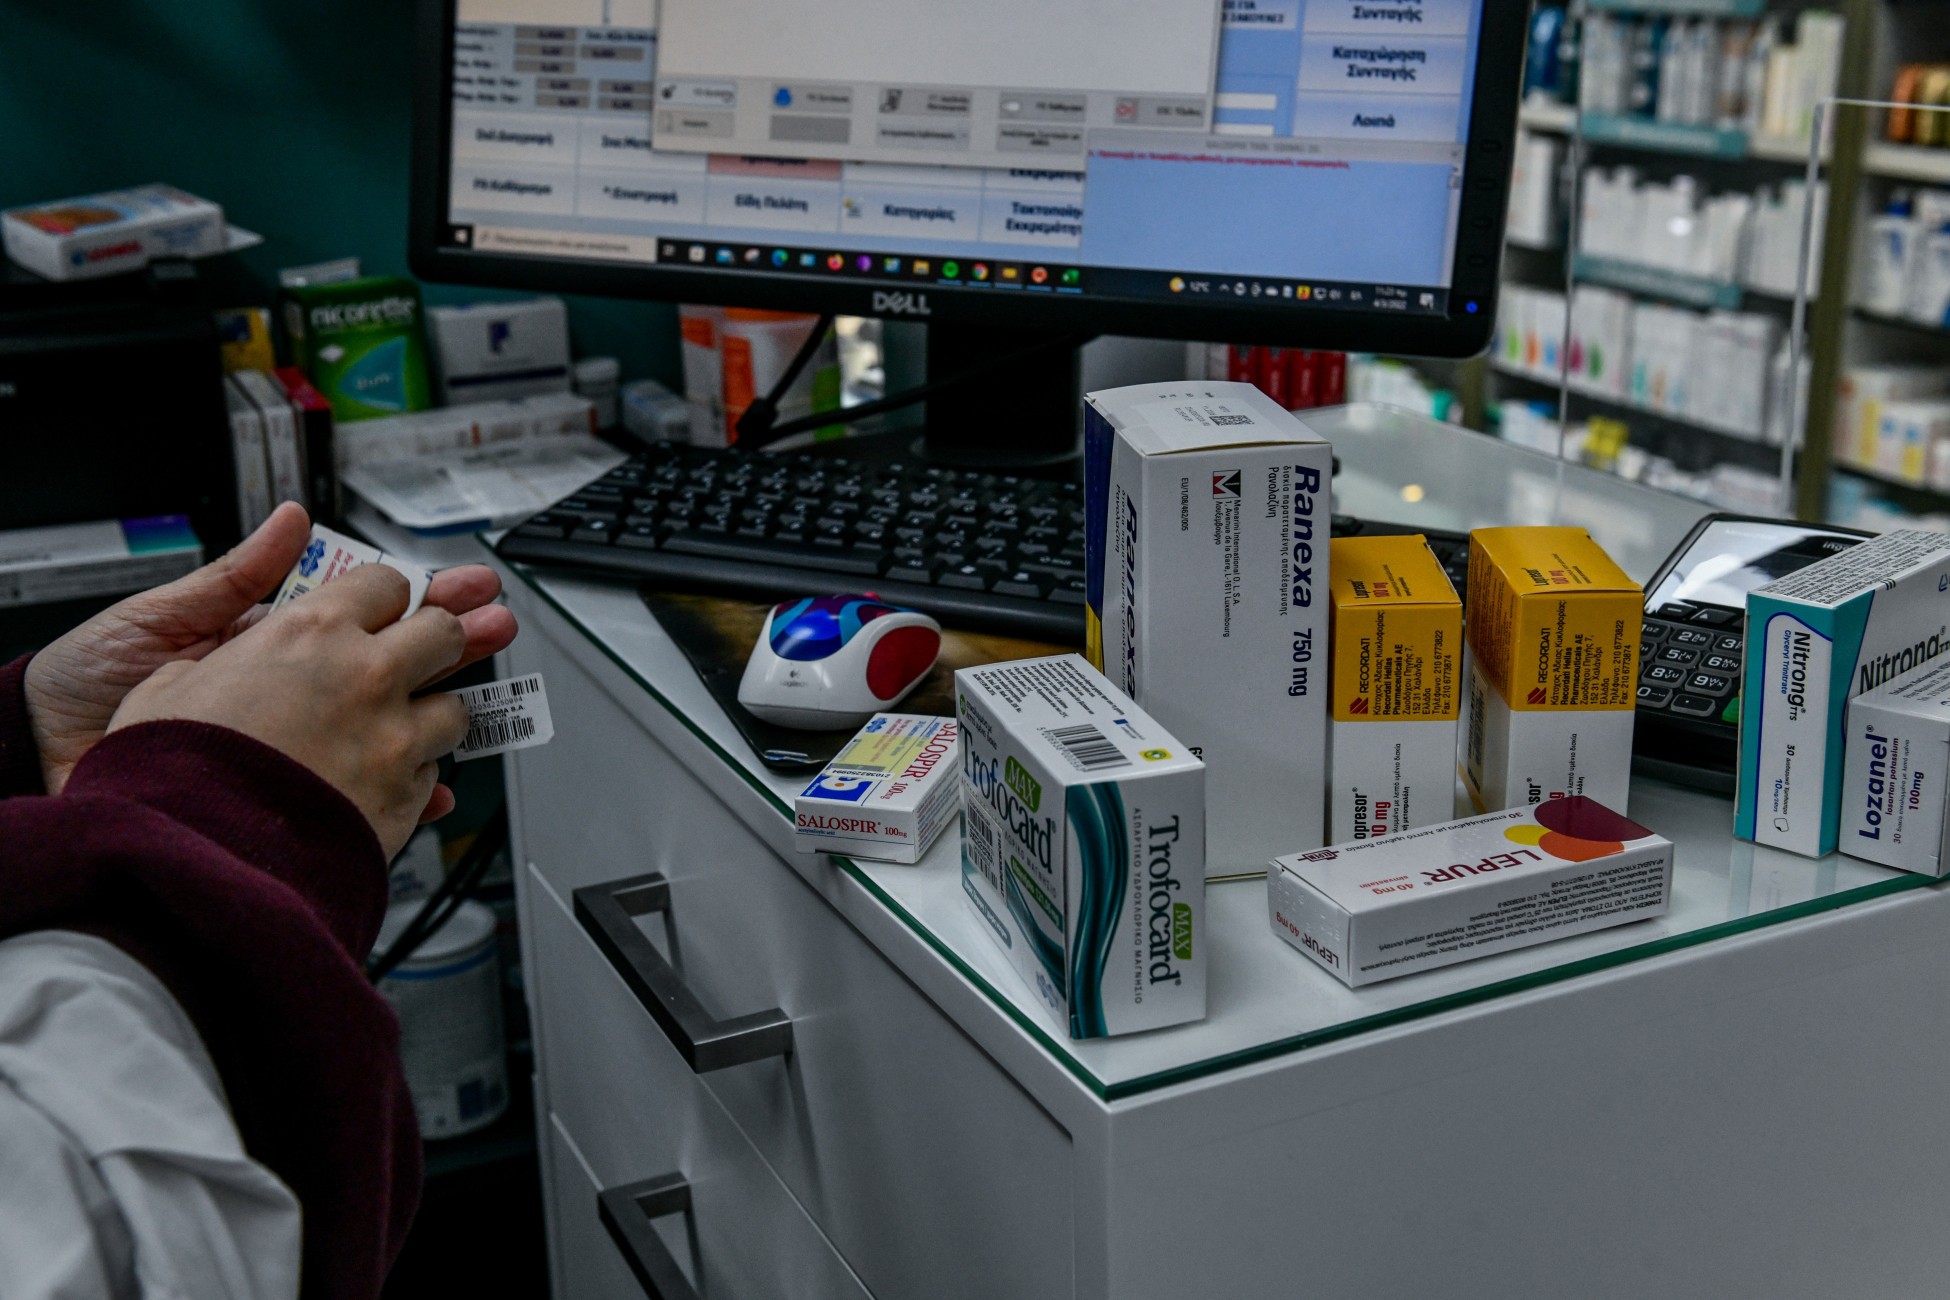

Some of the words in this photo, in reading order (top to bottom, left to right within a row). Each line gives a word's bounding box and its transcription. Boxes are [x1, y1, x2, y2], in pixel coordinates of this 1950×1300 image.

[1353, 6, 1422, 22] Συνταγής
[1332, 46, 1426, 66] Καταχώρηση
[1347, 64, 1416, 81] Συνταγής
[1352, 113, 1395, 128] Λοιπά
[764, 194, 808, 212] Πελάτη
[884, 204, 955, 222] Κατηγορίες
[872, 291, 931, 315] DELL
[1282, 465, 1291, 491] δισκία
[1266, 467, 1279, 517] Ρανολαζίνη
[1280, 494, 1290, 555] παρατεταμένης
[1292, 464, 1320, 608] Ranexa
[1224, 535, 1231, 543] de
[1223, 553, 1231, 571] Gare,
[1232, 532, 1240, 574] International
[1124, 495, 1137, 700] Ranexa
[1279, 558, 1289, 615] αποδέσμευσης
[1222, 596, 1230, 637] Luxembourg
[1292, 628, 1311, 662] 750
[1574, 634, 1583, 644] AE
[1678, 632, 1692, 641] 2
[1722, 639, 1736, 648] 3
[1782, 629, 1791, 658] Glyceryl
[1394, 644, 1403, 653] AE
[1537, 628, 1551, 683] RECORDATI
[1563, 647, 1571, 668] Hellas
[1582, 643, 1593, 666] Πηγής
[1613, 651, 1621, 663] 210
[1666, 649, 1680, 658] 5
[1359, 638, 1372, 693] RECORDATI
[1383, 657, 1392, 678] Hellas
[1403, 653, 1413, 676] Πηγής
[1412, 656, 1423, 689] Χαλάνδρι
[1433, 661, 1441, 672] 210
[1592, 646, 1603, 679] Χαλάνδρι
[1651, 668, 1665, 677] 8
[1708, 657, 1722, 666] 6
[1787, 631, 1810, 713] Nitrong®
[1288, 667, 1307, 696] mg
[1390, 656, 1404, 714] Pharmaceuticals
[1570, 646, 1582, 704] Pharmaceuticals
[1579, 669, 1591, 704] Ζωοδόχου
[1610, 665, 1621, 703] Τηλέφωνο:
[1621, 675, 1629, 688] 210
[1694, 676, 1708, 685] 9
[1780, 660, 1789, 694] Trinitrate
[1372, 684, 1383, 714] Κάτοχος
[1382, 681, 1392, 714] Recordati
[1401, 678, 1413, 714] Ζωοδόχου
[1431, 675, 1443, 713] Τηλέφωνο:
[1442, 685, 1450, 697] 210
[1550, 674, 1561, 704] Κάτοχος
[1560, 671, 1570, 704] Recordati
[1590, 692, 1598, 703] 152
[1599, 677, 1609, 704] Ελλάδα
[1412, 702, 1420, 713] 152
[1421, 688, 1431, 714] Ελλάδα
[1788, 706, 1797, 721] TTS
[1393, 743, 1401, 760] δισκία
[1569, 733, 1577, 750] δισκία
[1785, 744, 1795, 756] 30
[1888, 737, 1899, 780] potassium
[880, 780, 908, 800] 100mg
[1009, 760, 1036, 808] MAX
[1856, 724, 1888, 840] Lozanel®
[1908, 770, 1924, 811] 100mg
[959, 721, 1057, 875] Trofocard®
[1885, 781, 1895, 815] losartan
[1352, 787, 1369, 839] opresor®
[1374, 801, 1391, 819] mg
[1508, 810, 1524, 820] 30
[798, 814, 881, 833] SALOSPIR®
[885, 827, 907, 838] 100mg
[1405, 829, 1434, 840] λεπτό
[1893, 832, 1901, 843] 30
[1344, 841, 1374, 853] δισκία
[1374, 835, 1405, 846] υμένιο
[1420, 849, 1543, 886] LEPUR®
[1372, 886, 1395, 896] mg
[1396, 882, 1414, 892] 40
[1148, 814, 1180, 986] Trofocard®
[1175, 910, 1189, 950] MAX
[1275, 911, 1290, 926] mg
[1286, 922, 1300, 937] 40
